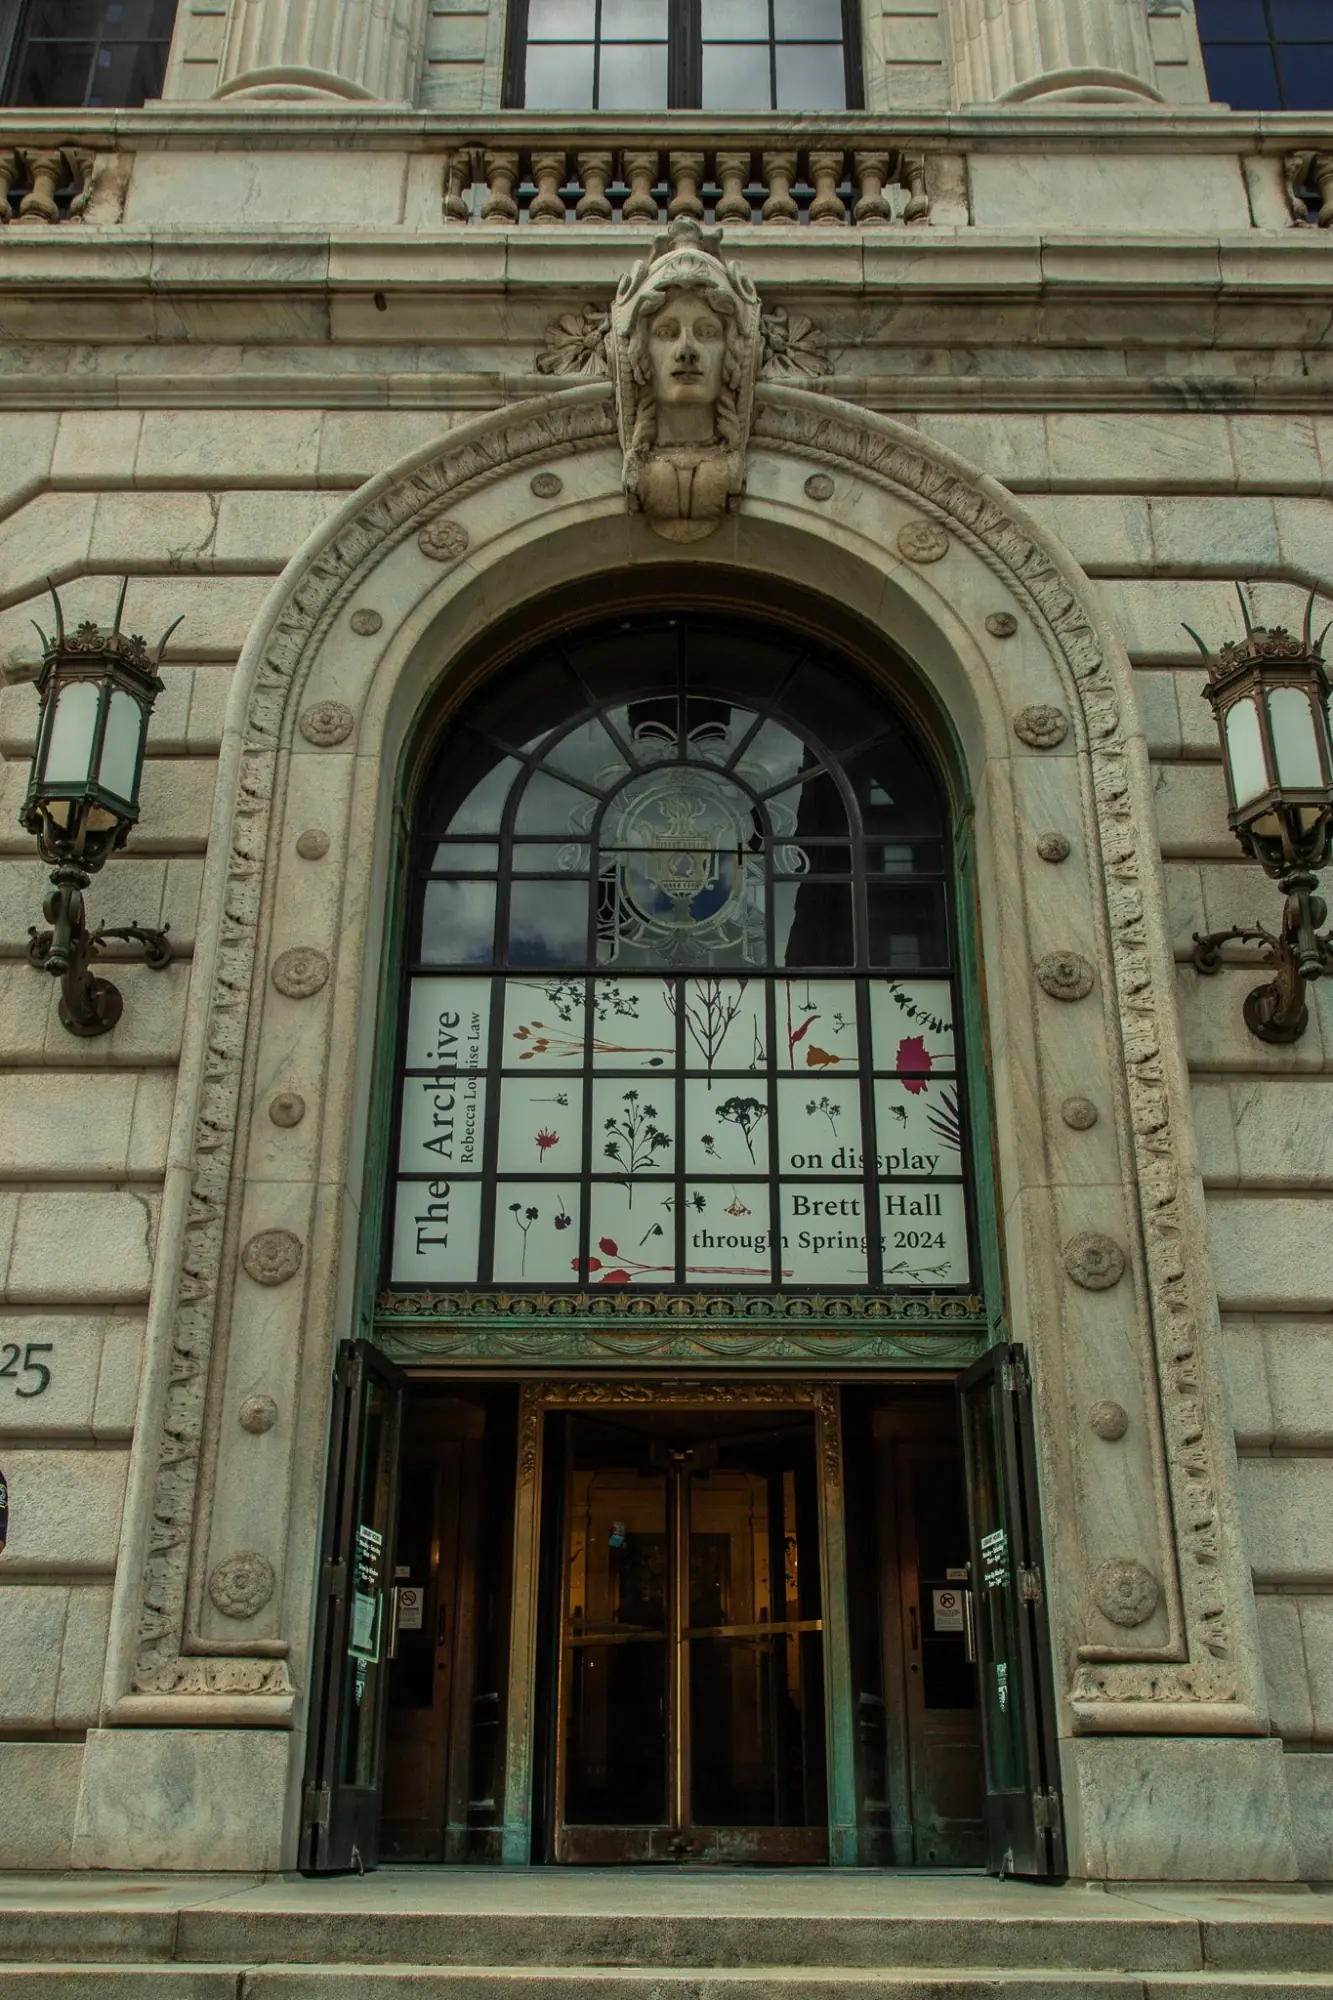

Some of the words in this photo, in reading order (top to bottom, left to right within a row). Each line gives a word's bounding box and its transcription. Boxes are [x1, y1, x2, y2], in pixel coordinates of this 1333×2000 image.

[467, 1011, 481, 1041] Law
[422, 1011, 461, 1161] Archive
[463, 1045, 480, 1100] Louise
[460, 1104, 477, 1164] Rebecca
[790, 1153, 824, 1169] on
[831, 1147, 940, 1175] display
[415, 1180, 451, 1255] The
[791, 1195, 861, 1216] Brett
[885, 1193, 942, 1216] Hall
[692, 1229, 789, 1254] through
[798, 1231, 887, 1254] Spring
[894, 1231, 947, 1249] 2024
[0, 1343, 53, 1398] 25
